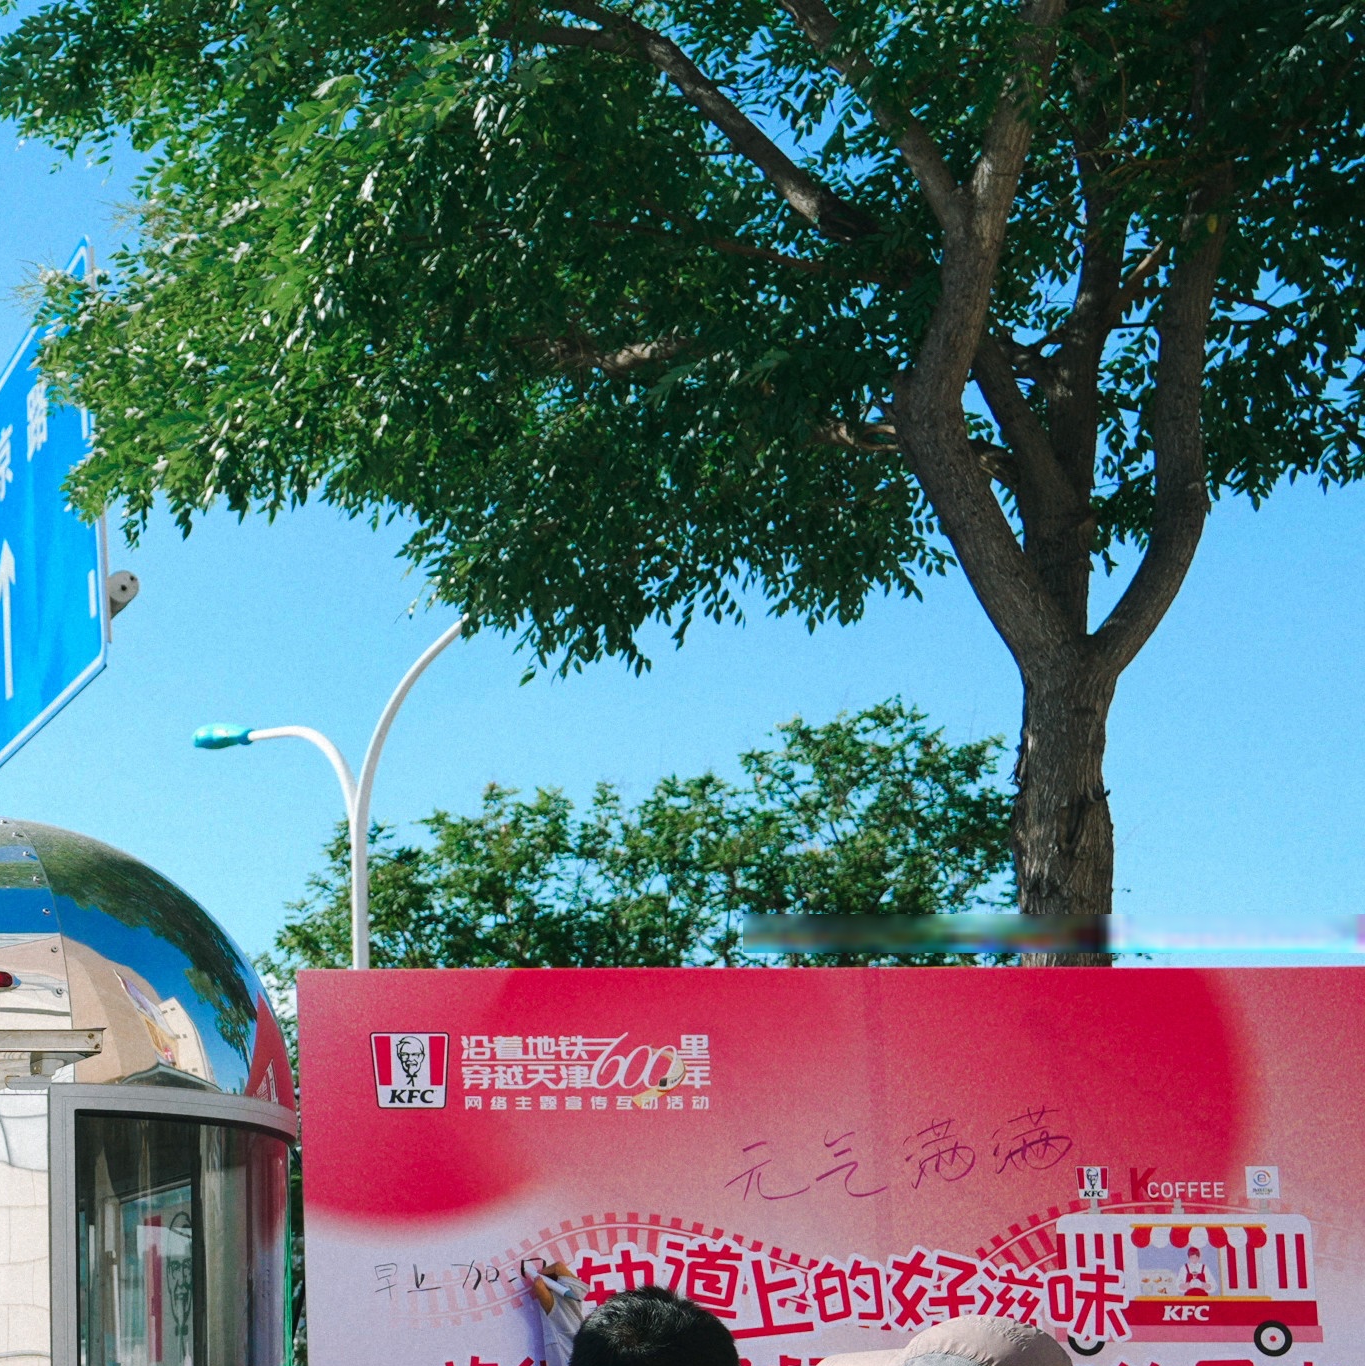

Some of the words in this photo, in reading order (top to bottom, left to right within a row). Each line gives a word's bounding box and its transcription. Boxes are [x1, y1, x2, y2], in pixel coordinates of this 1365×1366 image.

[389, 1089, 436, 1104] KFC
[1083, 1190, 1104, 1198] KFC
[1147, 1181, 1226, 1198] COFFEE
[1162, 1305, 1210, 1321] KFC
